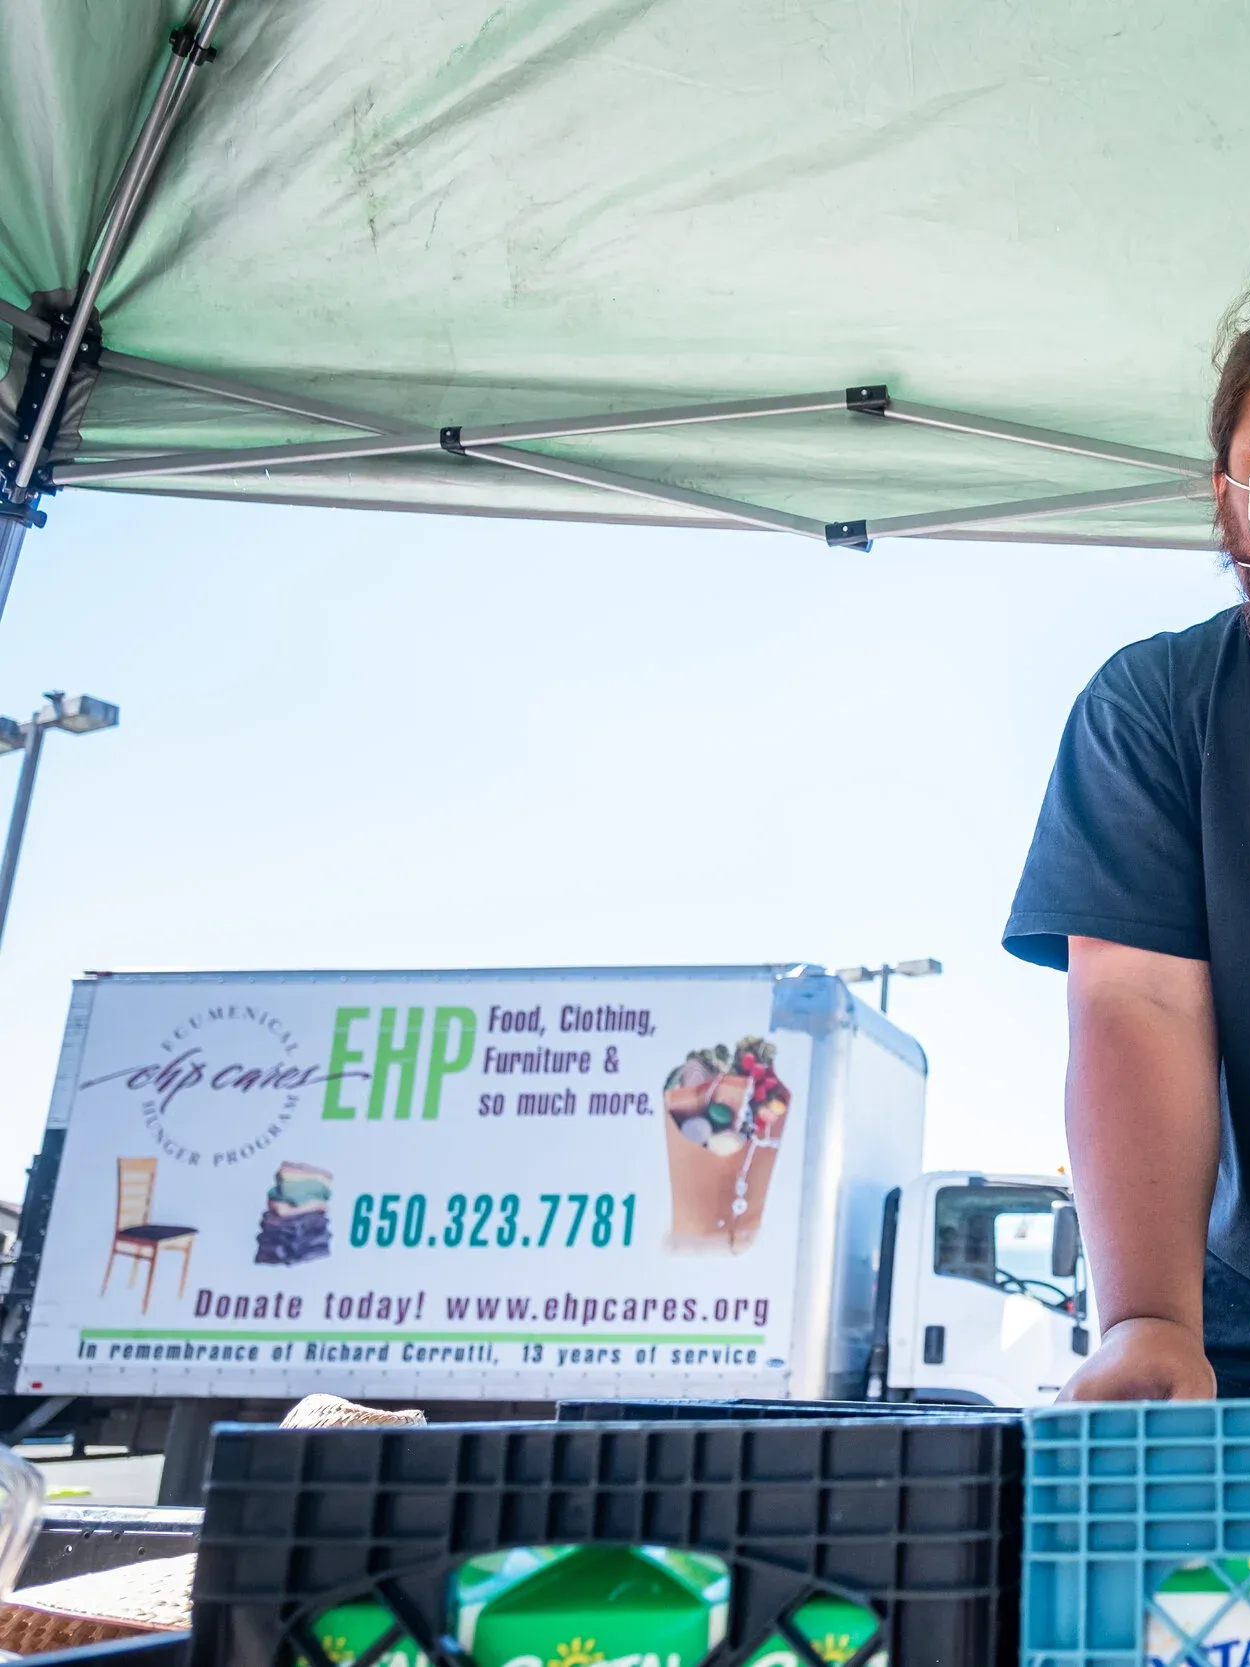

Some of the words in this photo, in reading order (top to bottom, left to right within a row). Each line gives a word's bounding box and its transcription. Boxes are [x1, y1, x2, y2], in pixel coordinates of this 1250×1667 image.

[161, 1005, 298, 1055] ECUMENICAL
[488, 1005, 546, 1037] Food,
[560, 1004, 656, 1036] Clothing,
[321, 1006, 478, 1120] EHP
[483, 1046, 591, 1074] Furniture
[603, 1045, 620, 1074] &
[478, 1092, 505, 1117] so
[517, 1087, 576, 1116] much
[589, 1092, 654, 1116] more.
[142, 1100, 200, 1166] HUNGER
[212, 1094, 299, 1167] PROGRAM
[349, 1193, 637, 1248] 650.323.7781
[194, 1288, 303, 1319] Donate
[324, 1289, 425, 1325] today!
[447, 1291, 769, 1327] www.ehpcares.org
[78, 1340, 97, 1360] In
[109, 1340, 259, 1361] remembrance
[271, 1341, 292, 1361] of
[304, 1342, 390, 1362] Richard
[523, 1343, 543, 1363] 13
[558, 1347, 621, 1366] years
[635, 1345, 657, 1364] of
[671, 1345, 758, 1365] service
